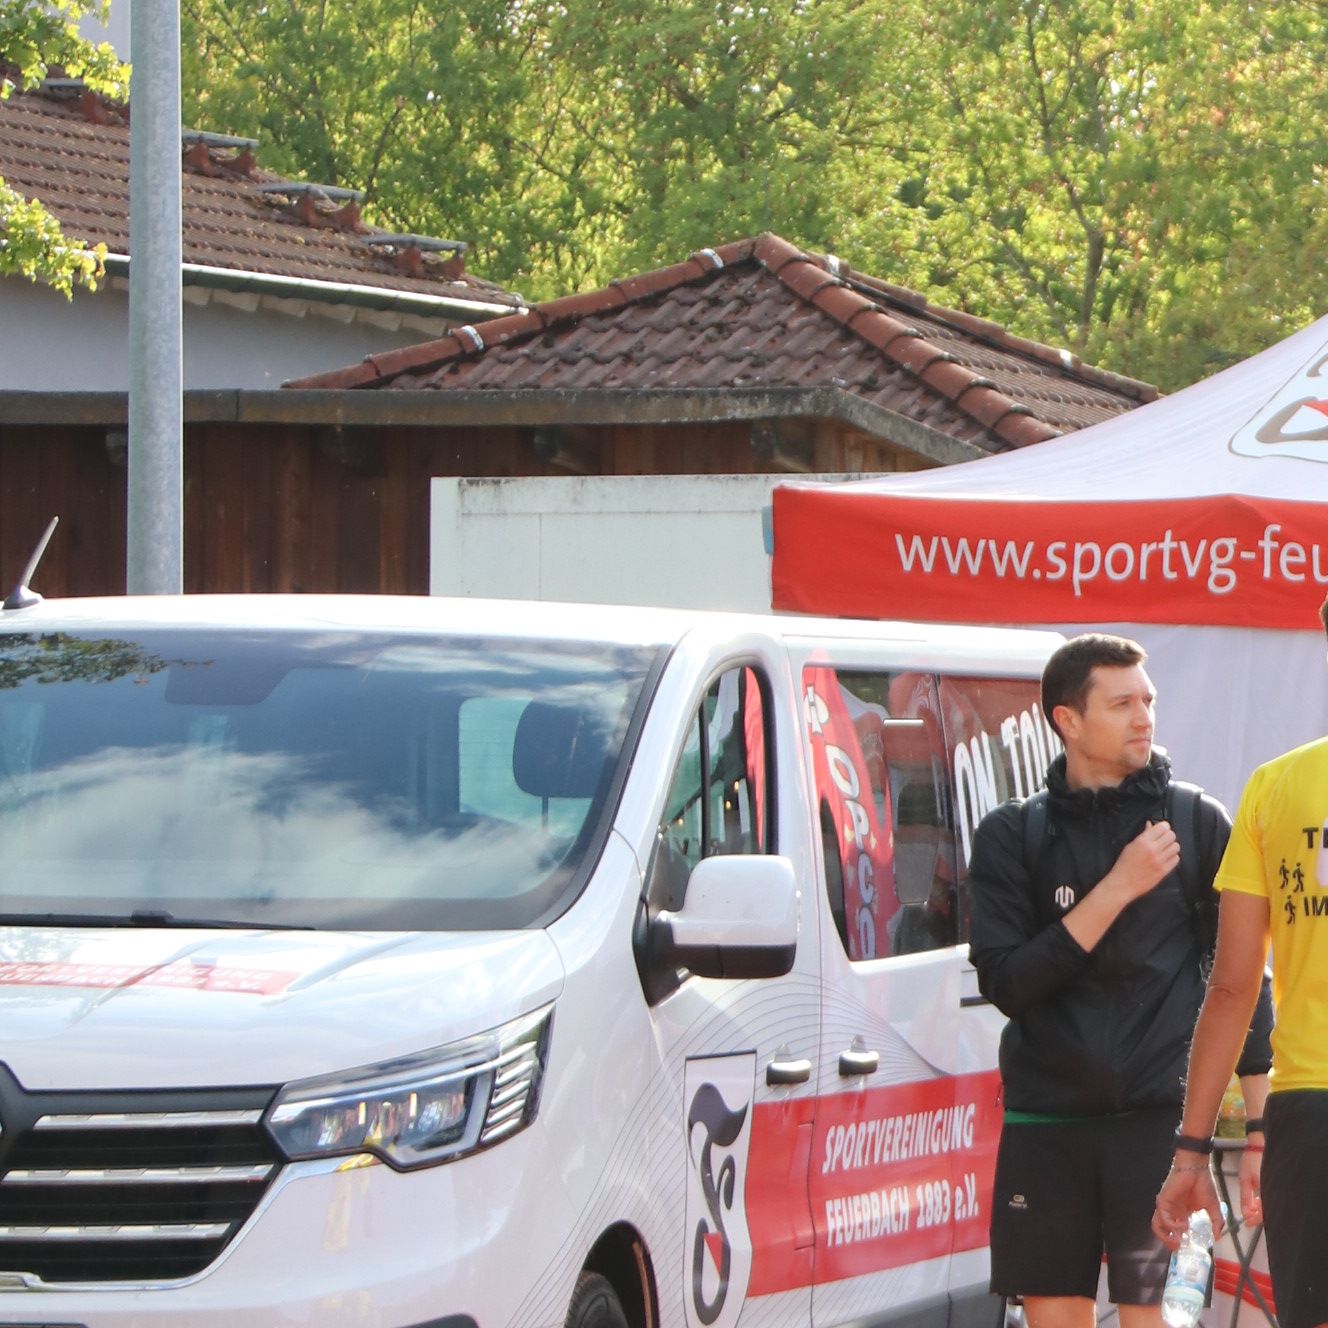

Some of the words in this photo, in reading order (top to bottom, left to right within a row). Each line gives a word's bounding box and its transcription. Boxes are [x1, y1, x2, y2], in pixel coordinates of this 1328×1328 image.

[821, 1102, 976, 1175] SPORTVEREINIGUNG
[825, 1185, 910, 1248] FEUERBACH
[915, 1179, 951, 1229] 1883
[954, 1172, 980, 1222] e.V.
